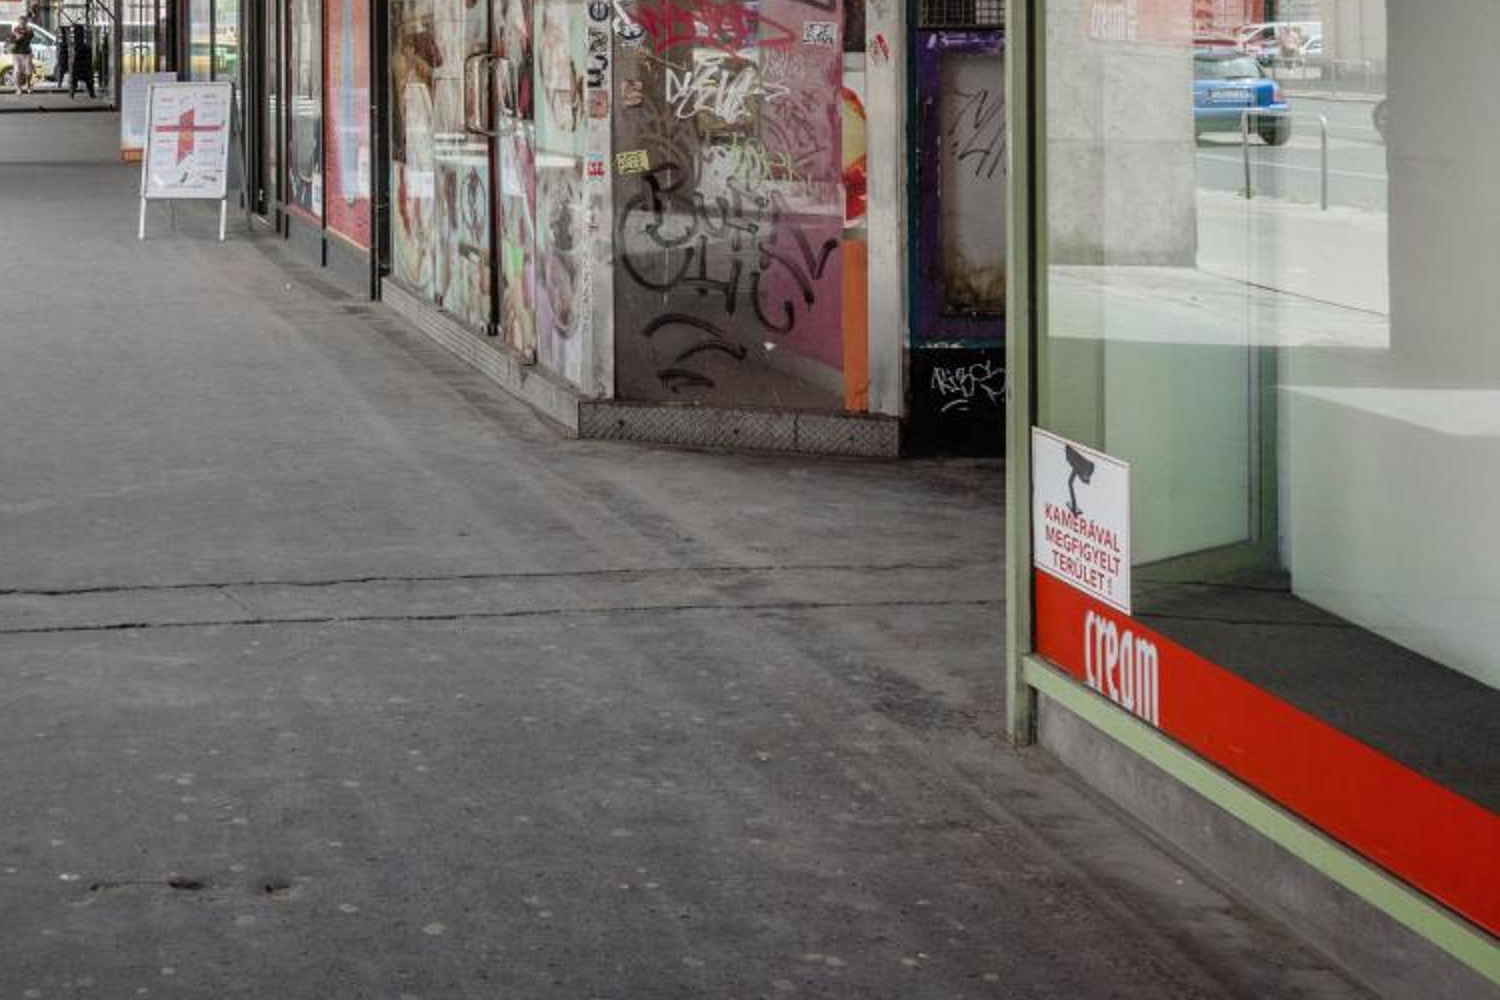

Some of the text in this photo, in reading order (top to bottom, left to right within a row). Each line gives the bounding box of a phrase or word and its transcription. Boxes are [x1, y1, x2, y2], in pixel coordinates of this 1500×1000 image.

[1044, 503, 1121, 553] KAMERÁVAL
[1045, 523, 1121, 577] MEGFIGYELT
[1083, 609, 1160, 728] cream
